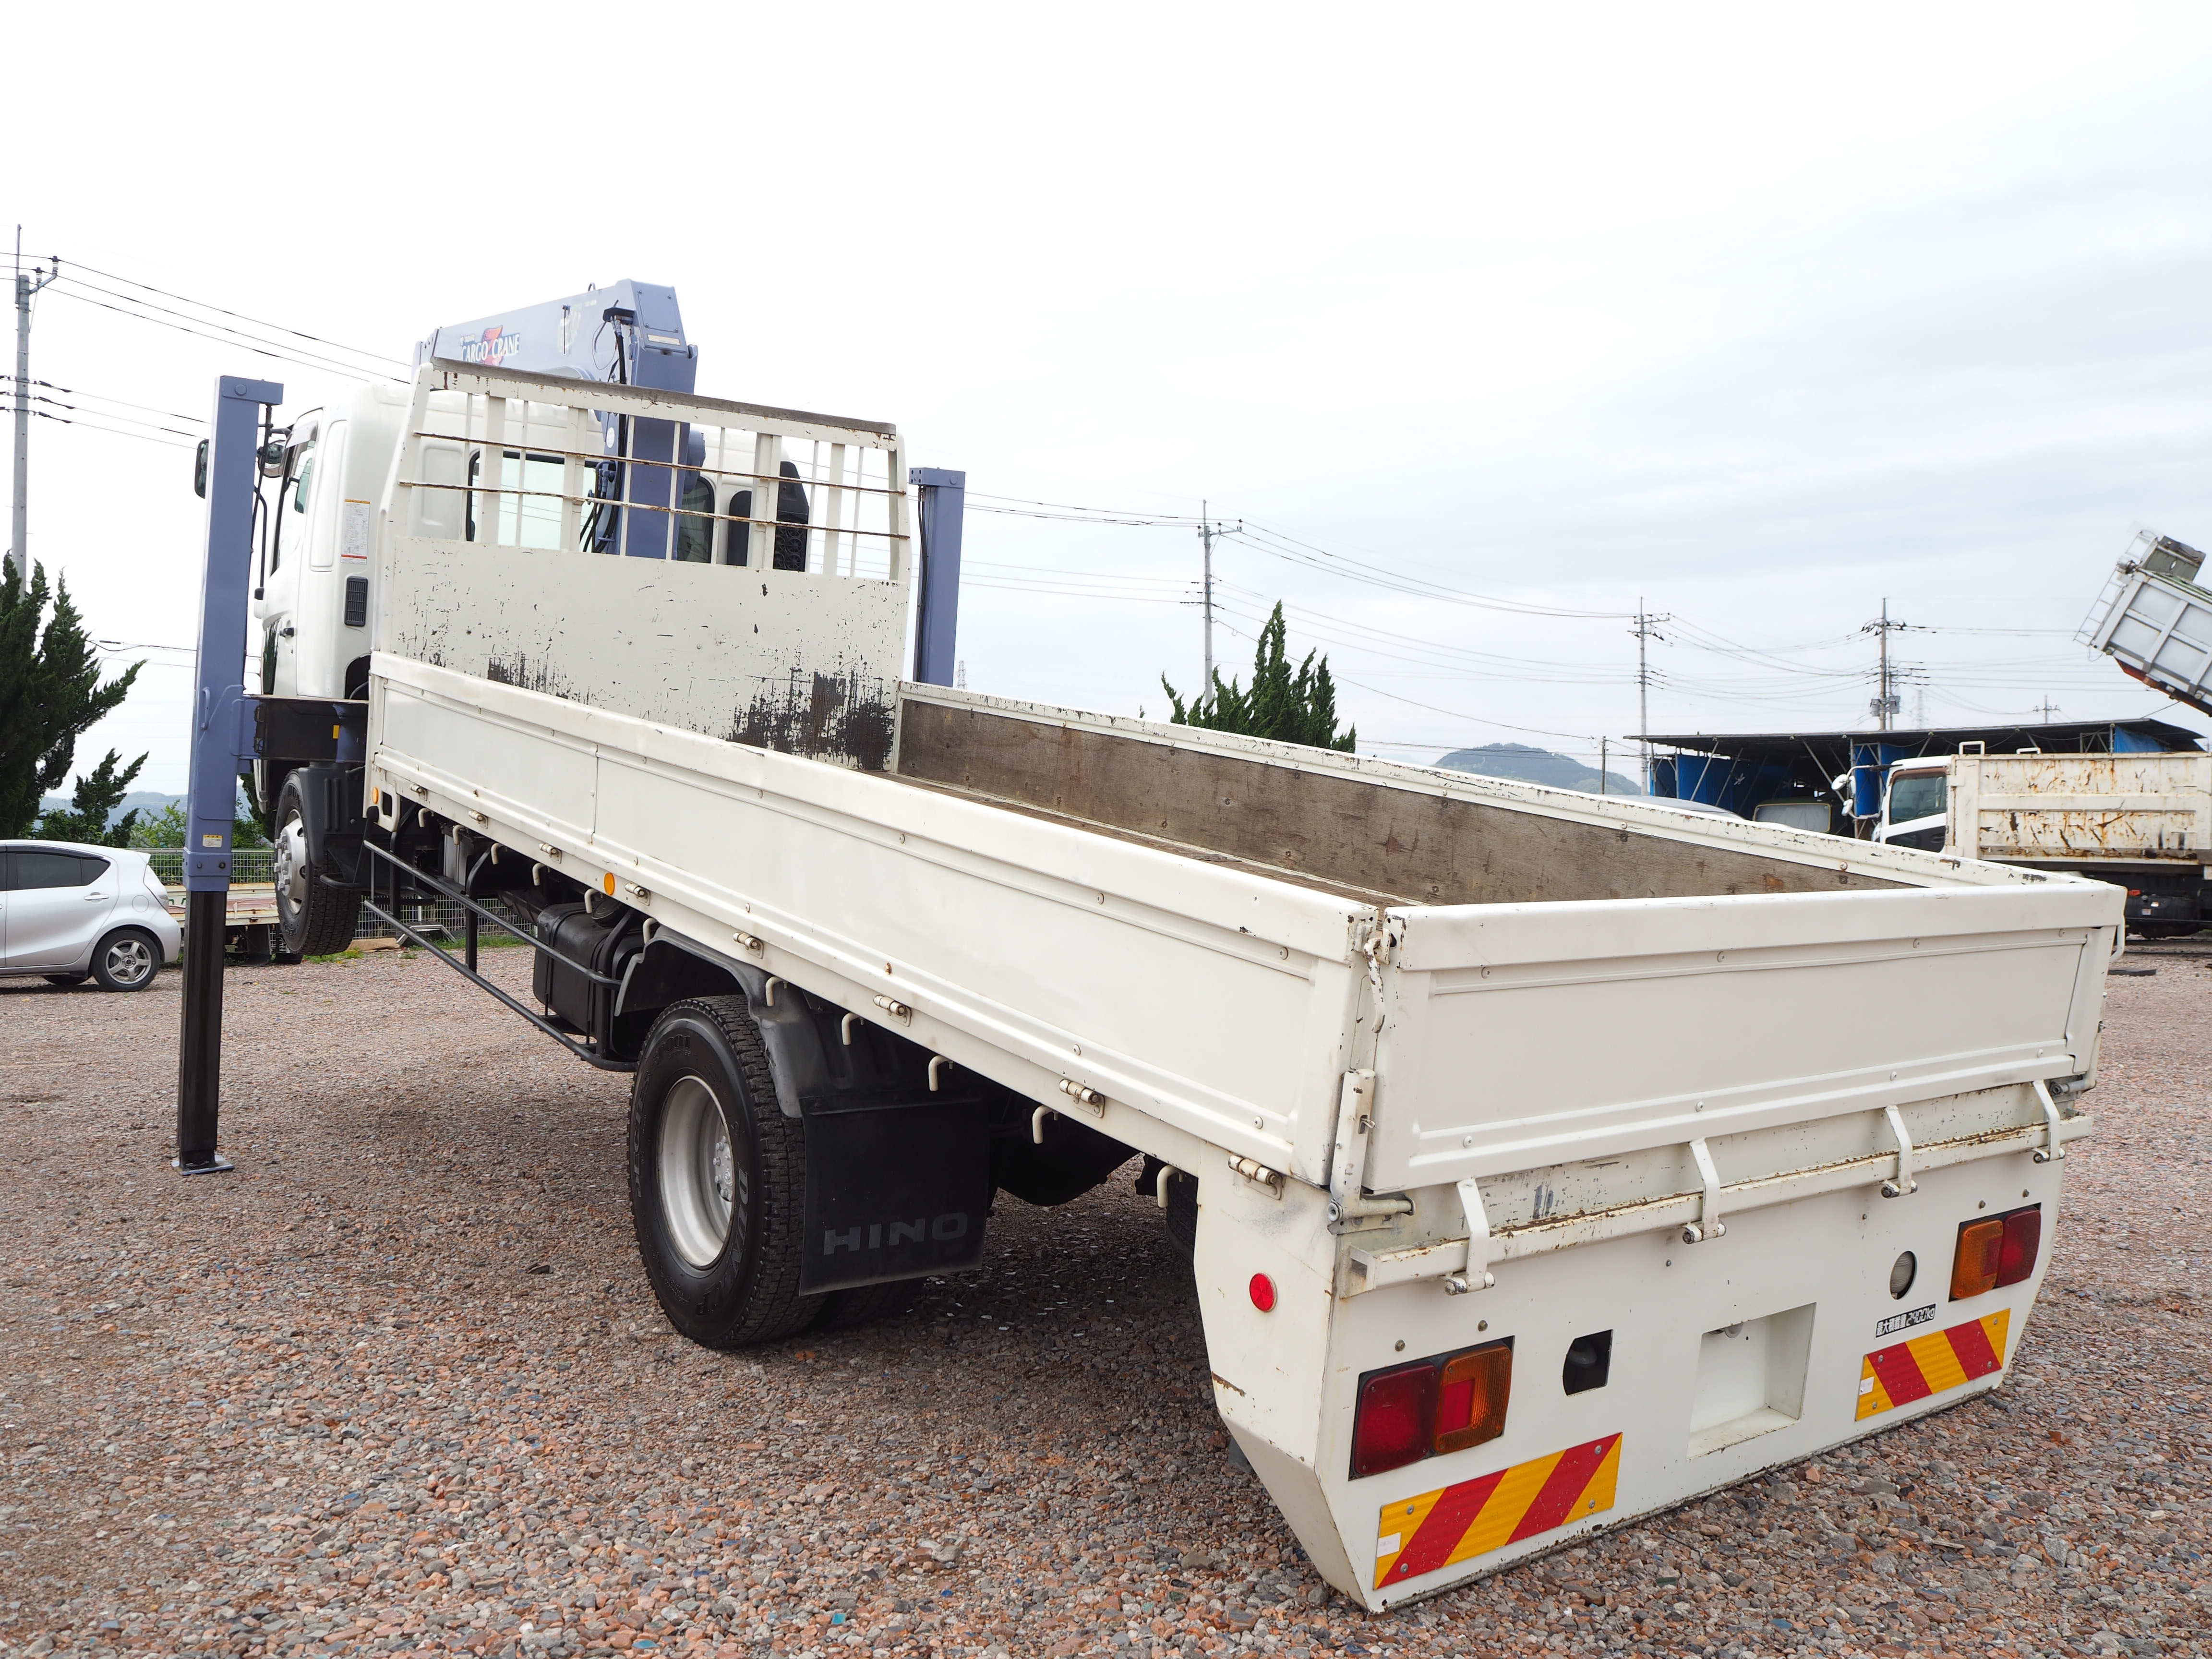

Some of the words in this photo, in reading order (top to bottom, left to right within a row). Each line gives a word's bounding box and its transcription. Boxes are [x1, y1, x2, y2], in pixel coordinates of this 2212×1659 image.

[461, 341, 488, 361] CARGO
[492, 334, 519, 359] CRANE
[823, 1212, 968, 1255] HINO
